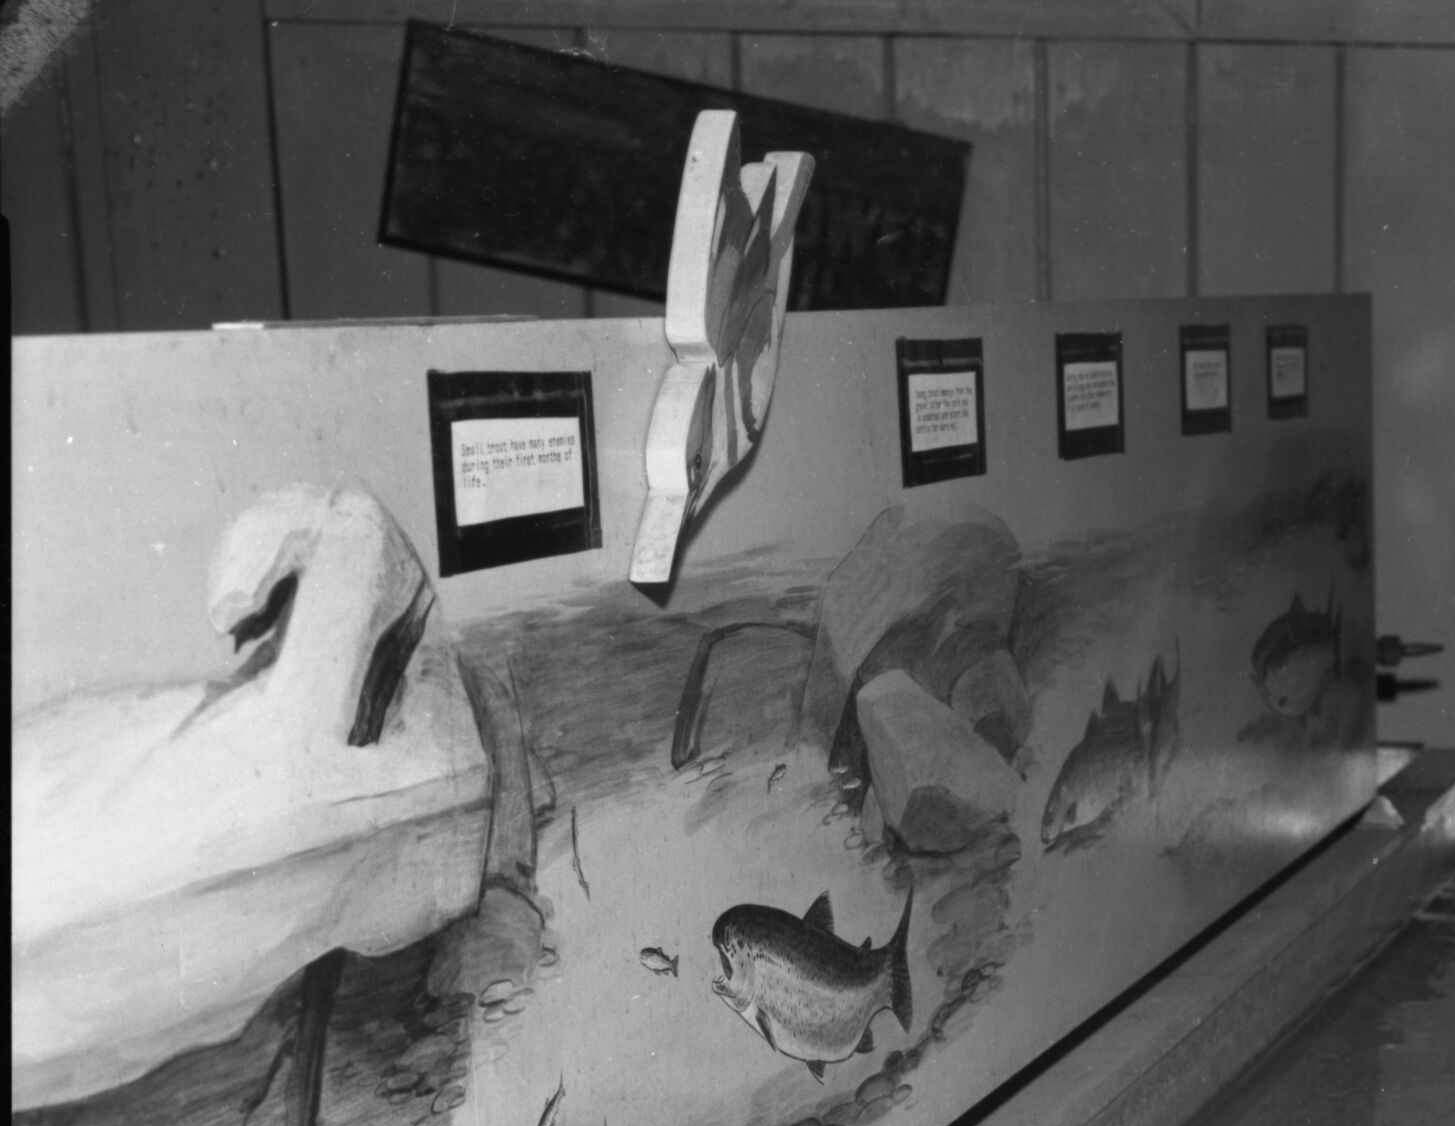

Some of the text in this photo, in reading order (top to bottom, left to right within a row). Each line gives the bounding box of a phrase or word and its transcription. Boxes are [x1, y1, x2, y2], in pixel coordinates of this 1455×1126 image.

[461, 435, 575, 456] Small trout have many enemies
[462, 447, 572, 474] during their first months of
[464, 474, 486, 488] life.
